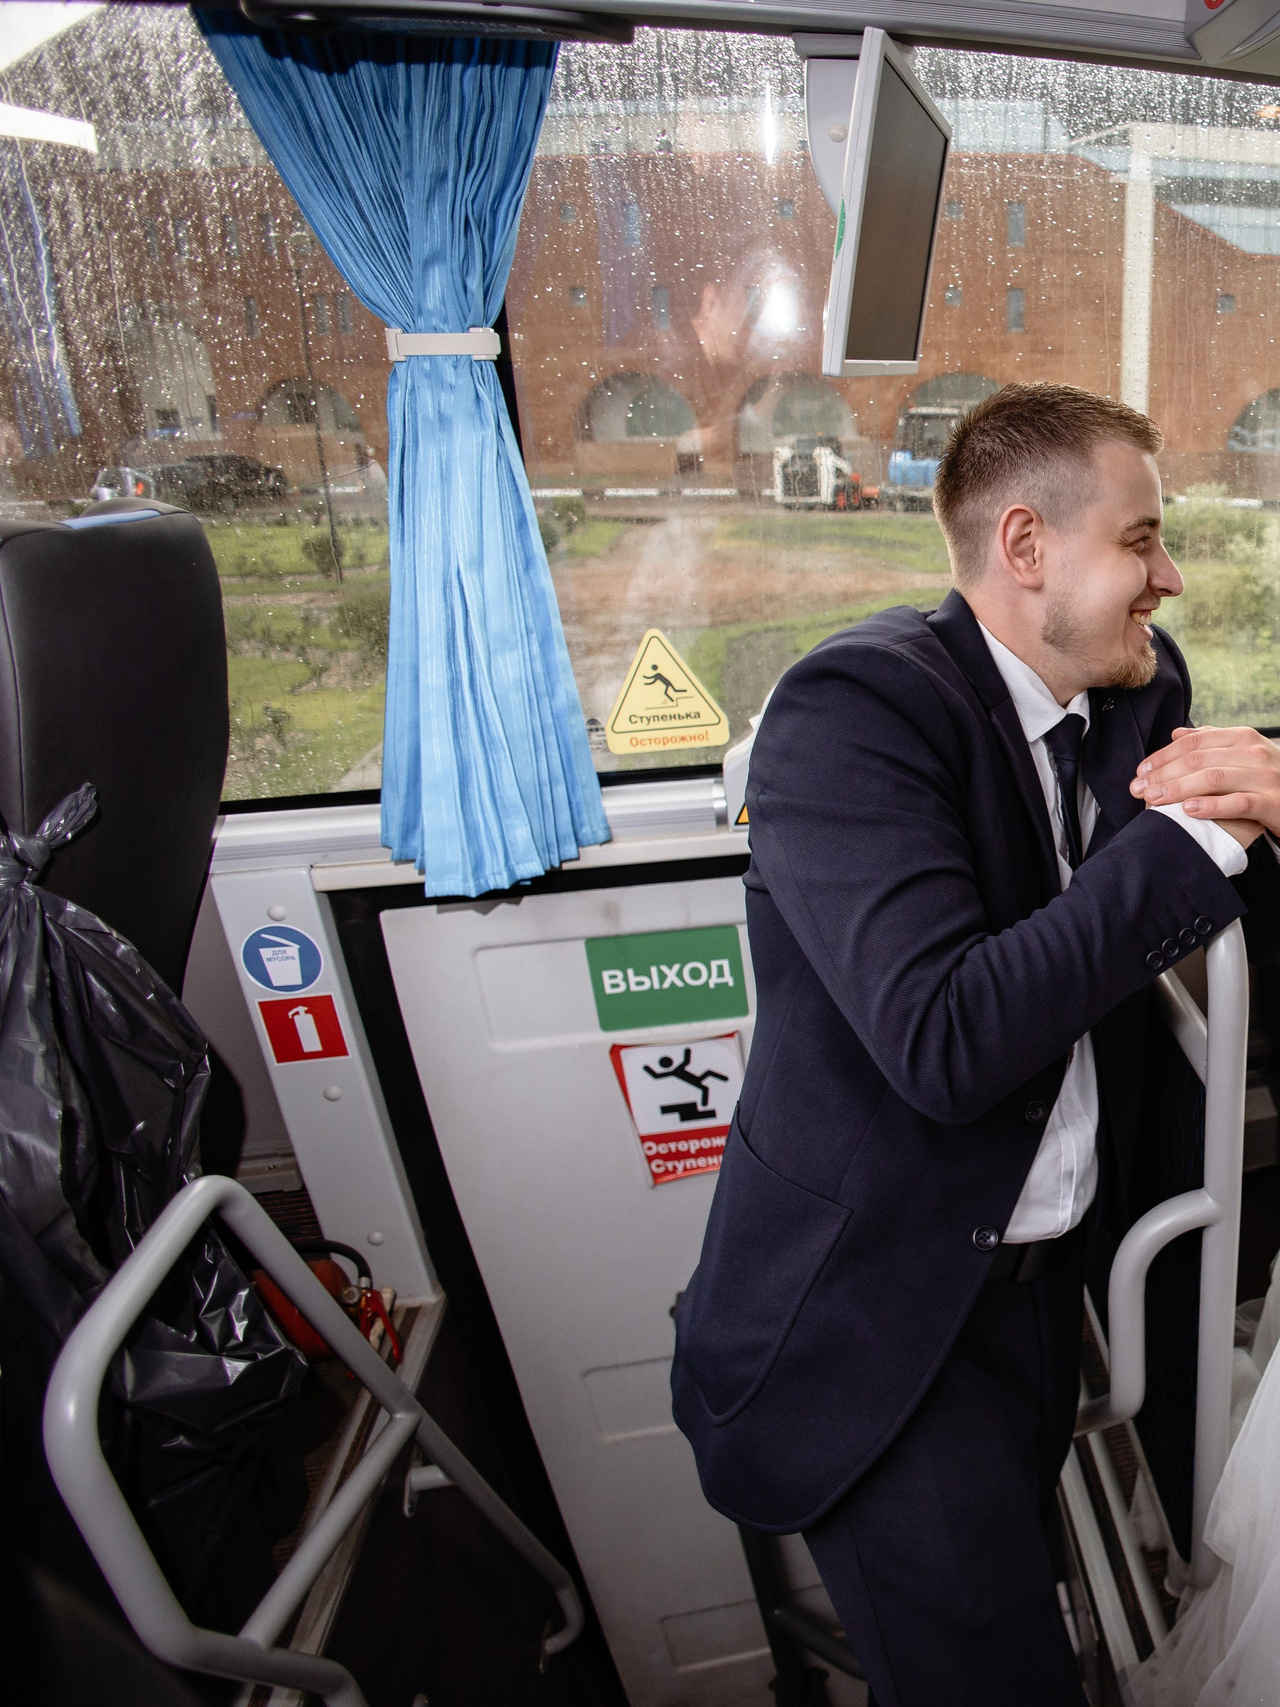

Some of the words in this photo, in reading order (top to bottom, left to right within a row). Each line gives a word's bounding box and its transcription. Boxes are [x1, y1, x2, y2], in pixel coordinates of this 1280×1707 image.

[628, 711, 701, 725] Ступенька
[629, 731, 709, 747] Осторожно!
[266, 955, 296, 963] МУСОРА
[272, 949, 287, 957] ДЛЯ
[601, 959, 734, 994] ВЫХОД
